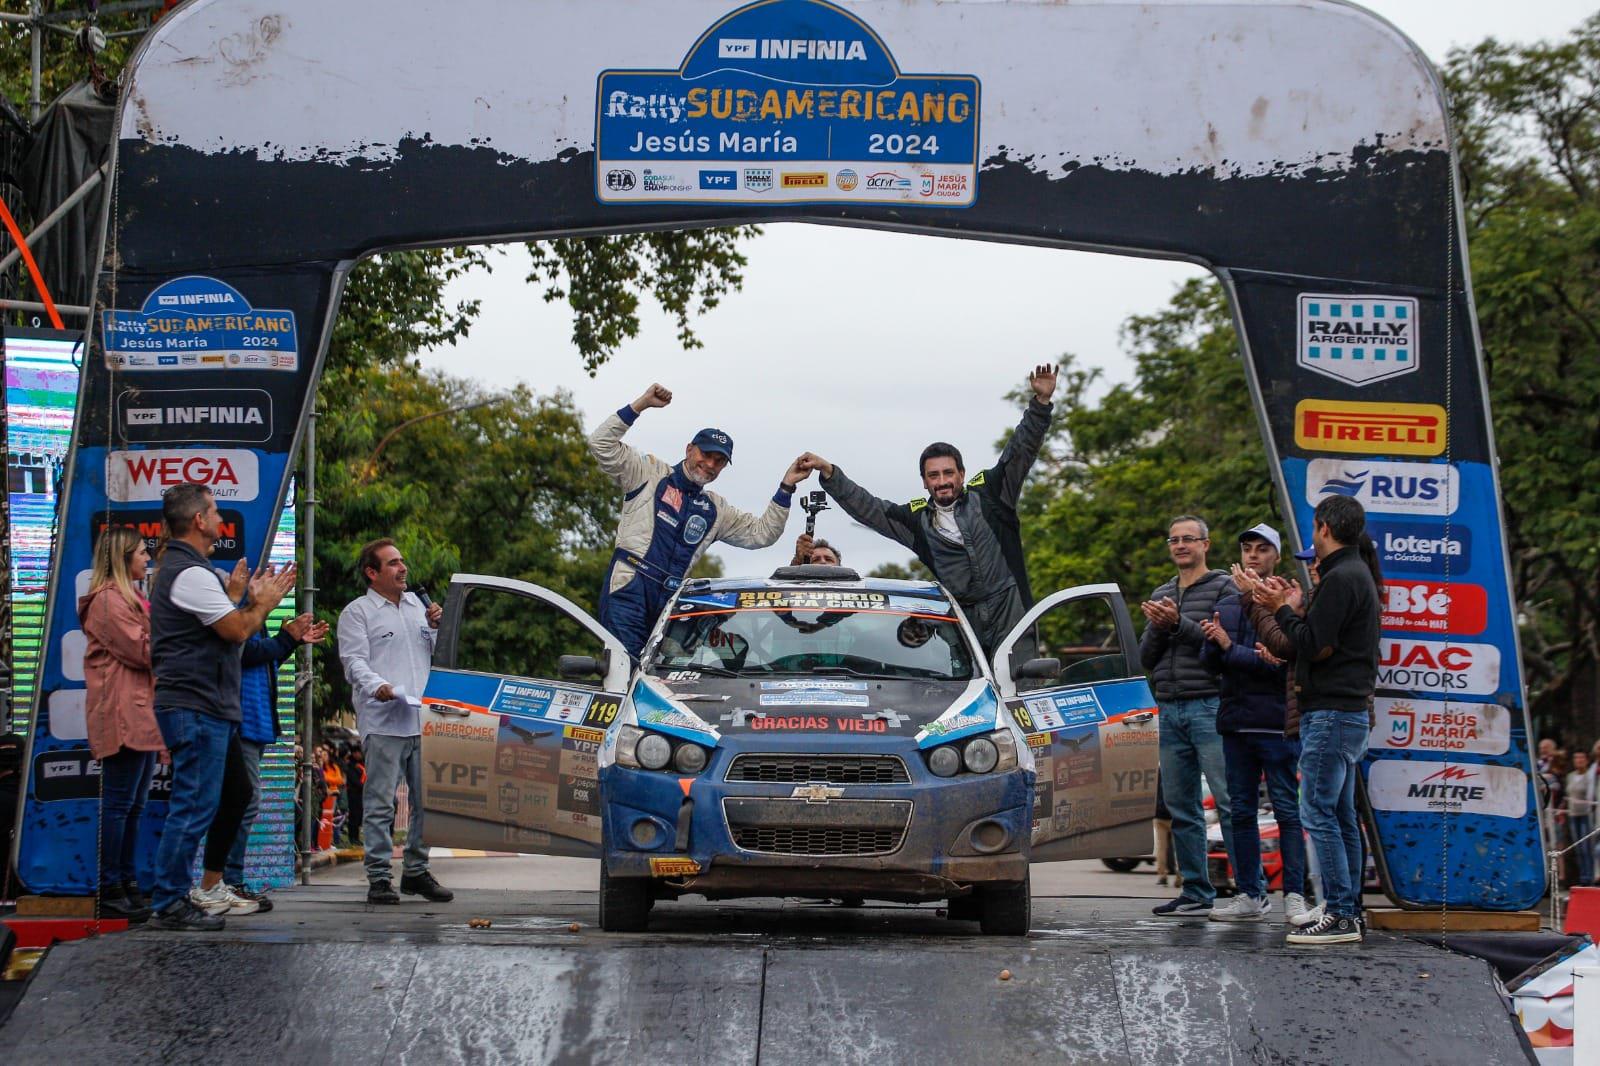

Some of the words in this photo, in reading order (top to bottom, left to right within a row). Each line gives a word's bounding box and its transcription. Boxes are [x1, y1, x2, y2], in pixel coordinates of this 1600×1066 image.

[725, 44, 751, 54] YPF
[761, 39, 867, 61] INFINIA
[605, 90, 687, 124] Rally
[687, 87, 969, 123] SUDAMERICANO
[629, 130, 711, 153] Jesús
[719, 130, 798, 154] María
[868, 133, 940, 155] 2024
[705, 176, 731, 185] YPF
[784, 175, 825, 185] PIRELLI
[937, 173, 967, 183] JESÚS
[937, 181, 967, 191] MARÍA
[180, 293, 235, 305] INFINIA
[1308, 320, 1408, 337] RALLY
[120, 338, 163, 349] Jesús
[166, 337, 208, 349] María
[242, 336, 279, 348] 2024
[1308, 335, 1409, 346] ARGENTINO
[166, 406, 264, 425] INFINIA
[1303, 410, 1439, 444] PIRELLI
[127, 455, 239, 486] WEGA
[1371, 475, 1439, 501] RUS
[1384, 533, 1462, 556] lotería
[739, 591, 783, 600] RIO
[789, 591, 885, 602] TURBIO
[741, 599, 818, 608] SANTA
[827, 600, 886, 610] CRUZ
[1378, 643, 1473, 671] JAC
[1376, 669, 1468, 689] MOTORS
[516, 687, 551, 700] INFINIA
[588, 700, 618, 723] 119
[1421, 711, 1478, 727] JESÚS
[434, 721, 496, 738] HIERROMEC
[751, 717, 829, 730] GRACIAS
[837, 718, 886, 733] VIEJO
[1420, 724, 1478, 740] MARÍA
[571, 727, 603, 742] PIRELLI
[573, 739, 598, 753] YPF
[1419, 738, 1465, 749] CIUDAD
[581, 754, 597, 763] RUS
[50, 764, 75, 772] YPF
[427, 760, 489, 787] YPF
[1111, 768, 1157, 793] YPF
[573, 788, 590, 798] FOX
[1407, 783, 1486, 802] MITRE
[655, 861, 698, 873] PIRELLI
